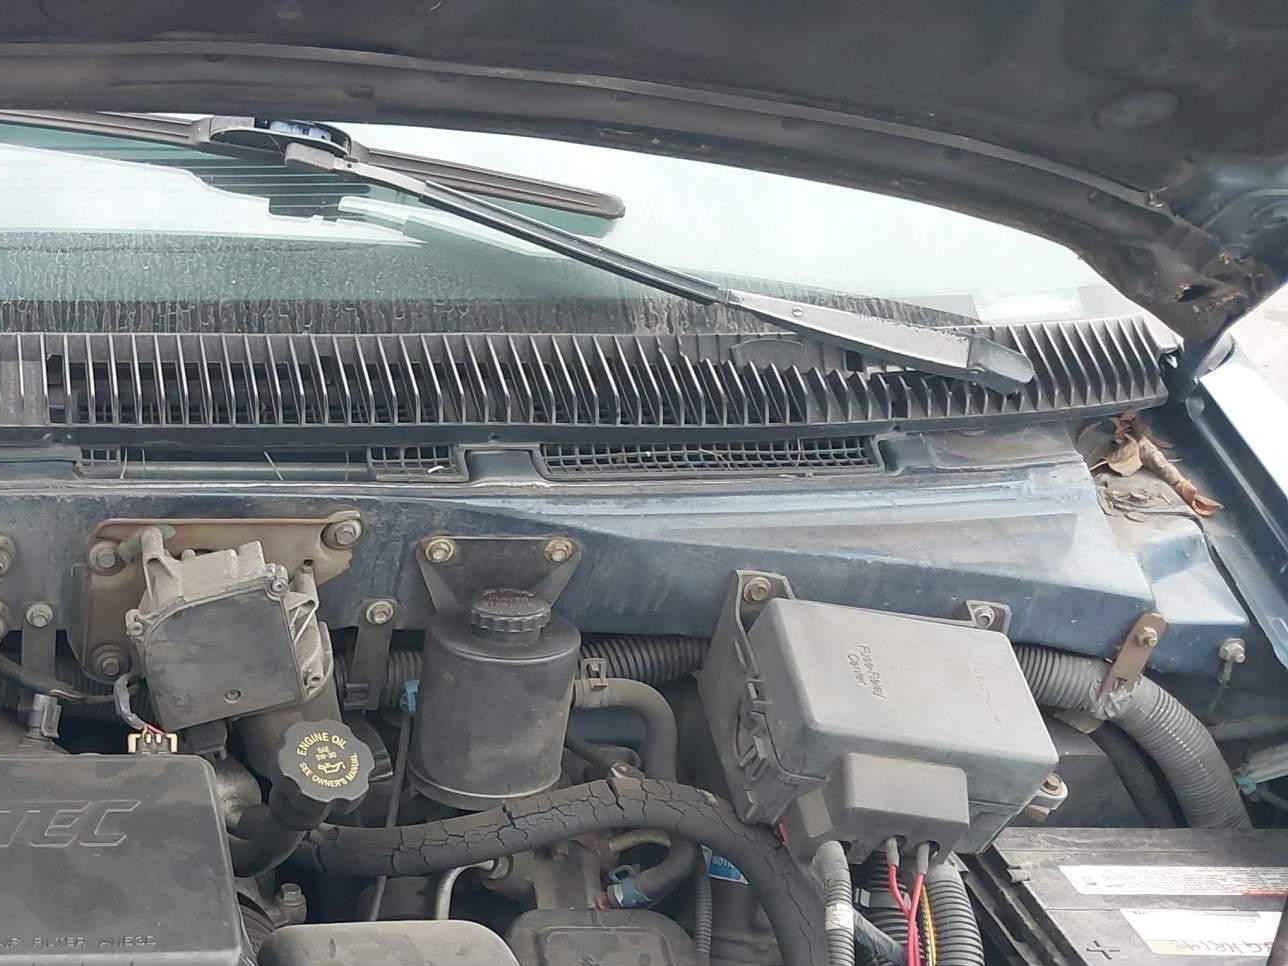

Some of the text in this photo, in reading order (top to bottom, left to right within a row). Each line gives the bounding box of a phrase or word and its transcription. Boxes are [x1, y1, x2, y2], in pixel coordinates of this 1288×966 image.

[297, 732, 347, 756] ENGINE OIL
[299, 762, 313, 777] SEE
[346, 752, 359, 782] MANUAL
